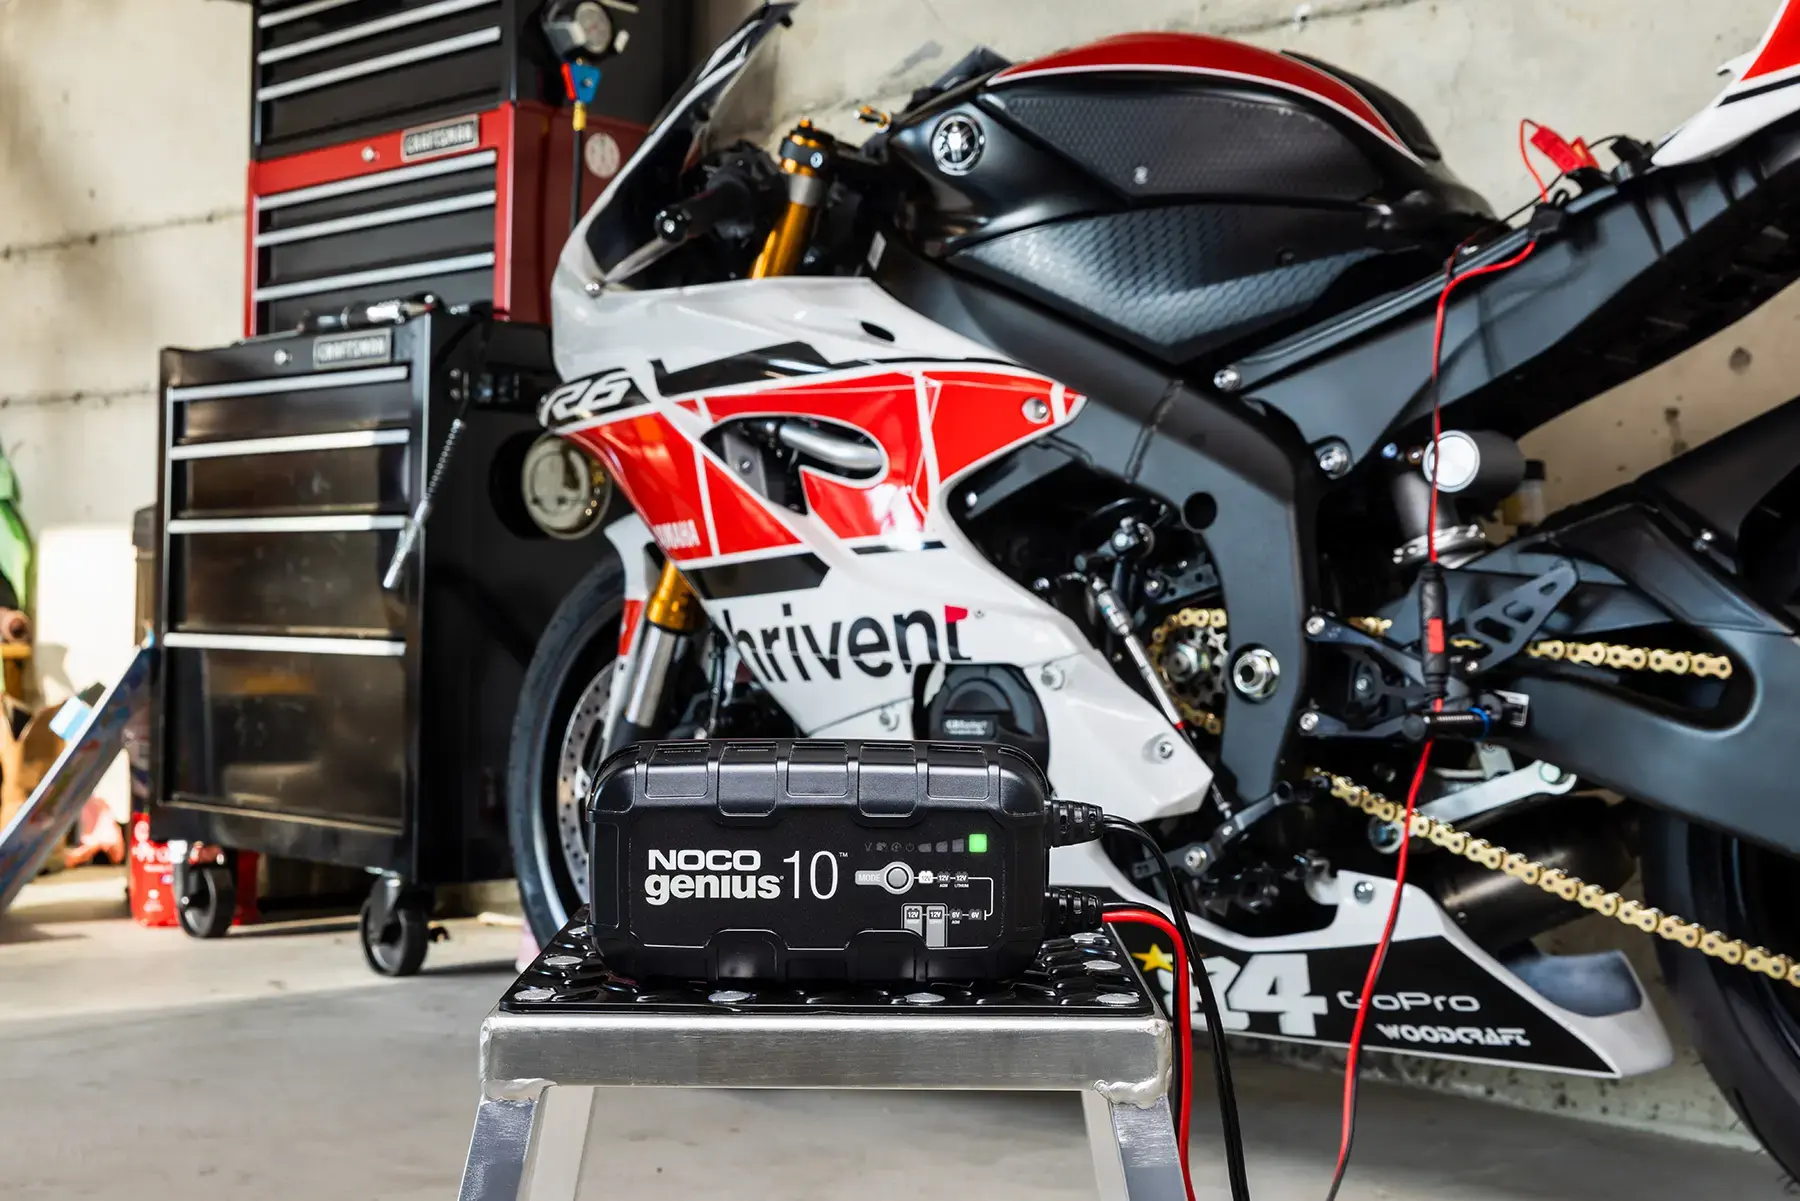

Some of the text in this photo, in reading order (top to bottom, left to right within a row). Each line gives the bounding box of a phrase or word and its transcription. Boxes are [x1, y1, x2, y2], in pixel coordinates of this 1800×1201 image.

[648, 849, 761, 871] NOCO
[858, 874, 881, 882] MODE
[938, 874, 949, 882] 12V
[955, 874, 967, 882] 12V
[907, 910, 979, 919] 12V 12V 6V 6V
[1375, 1023, 1532, 1047] WOODCRAFT
